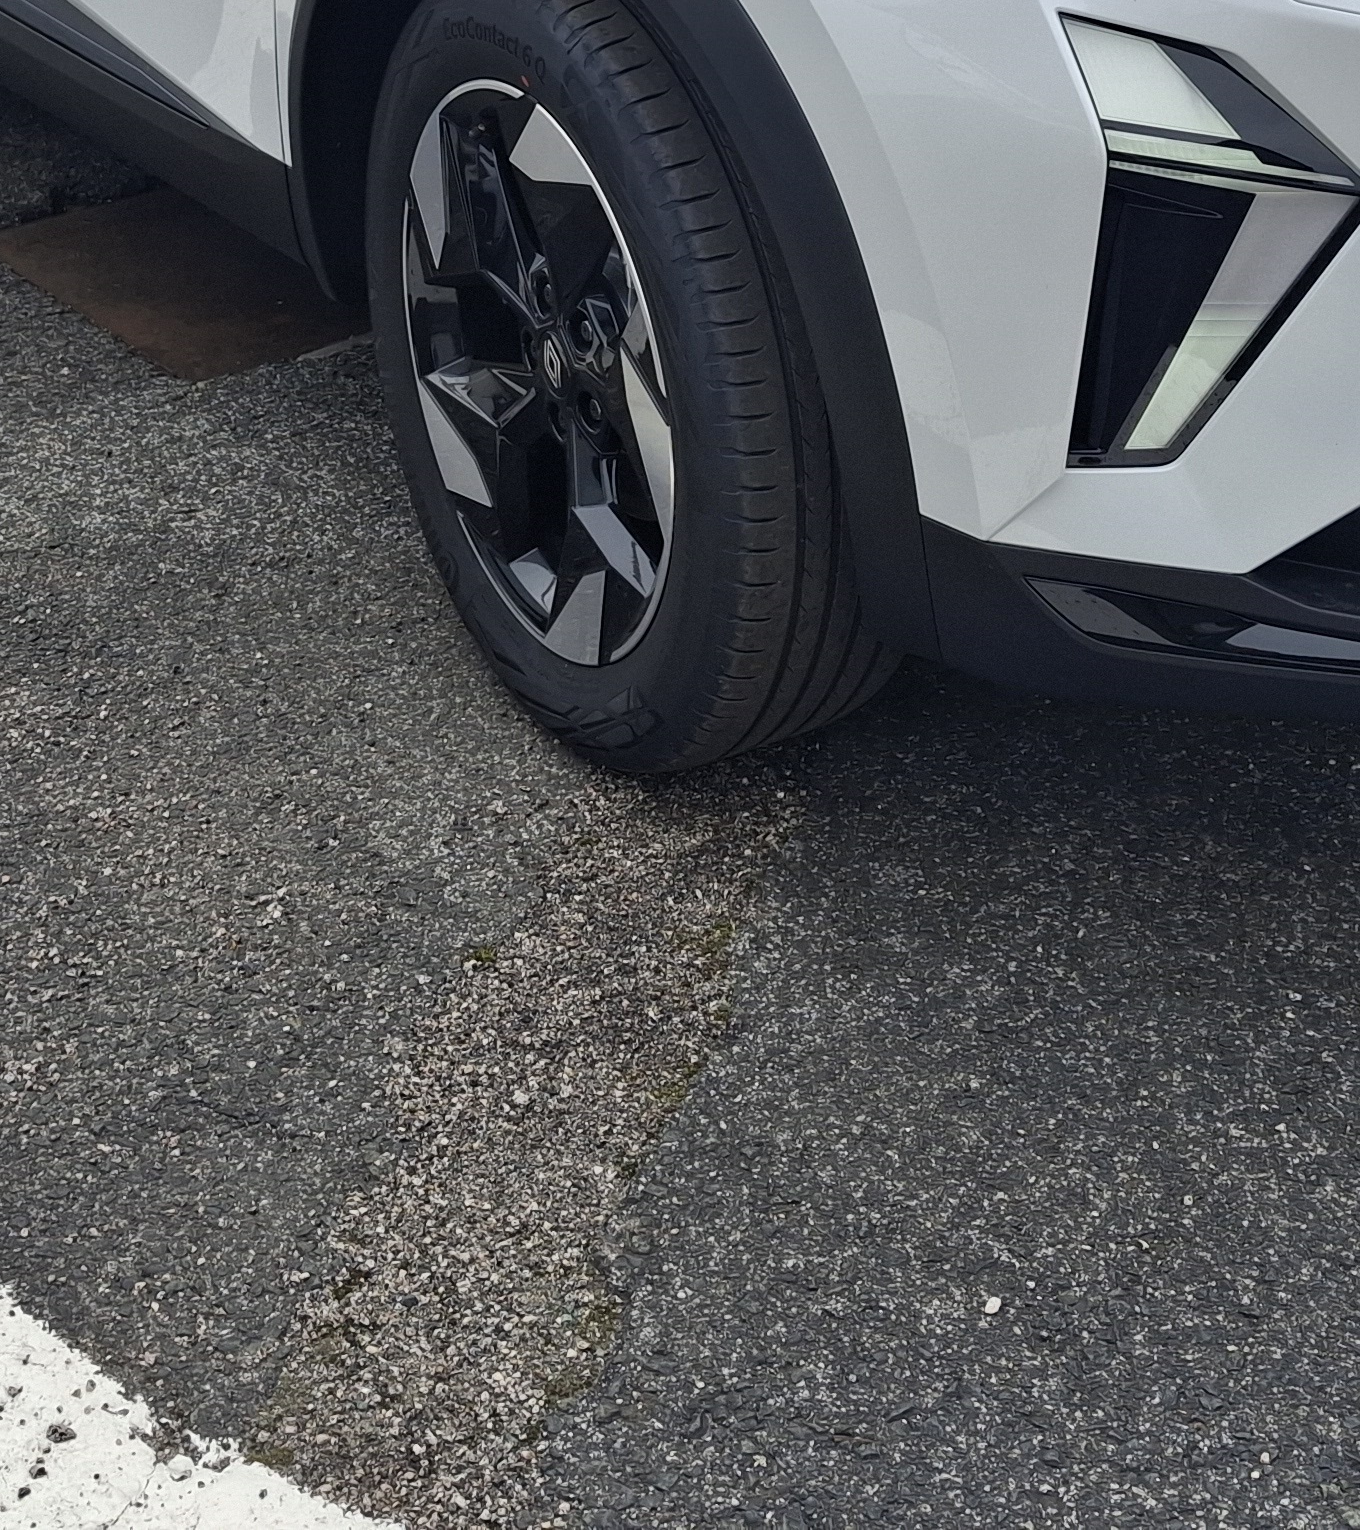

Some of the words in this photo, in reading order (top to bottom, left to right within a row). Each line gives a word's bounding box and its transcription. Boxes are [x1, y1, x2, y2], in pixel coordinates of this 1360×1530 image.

[442, 16, 519, 58] EcoContact
[522, 44, 533, 67] 6
[535, 56, 546, 86] Q
